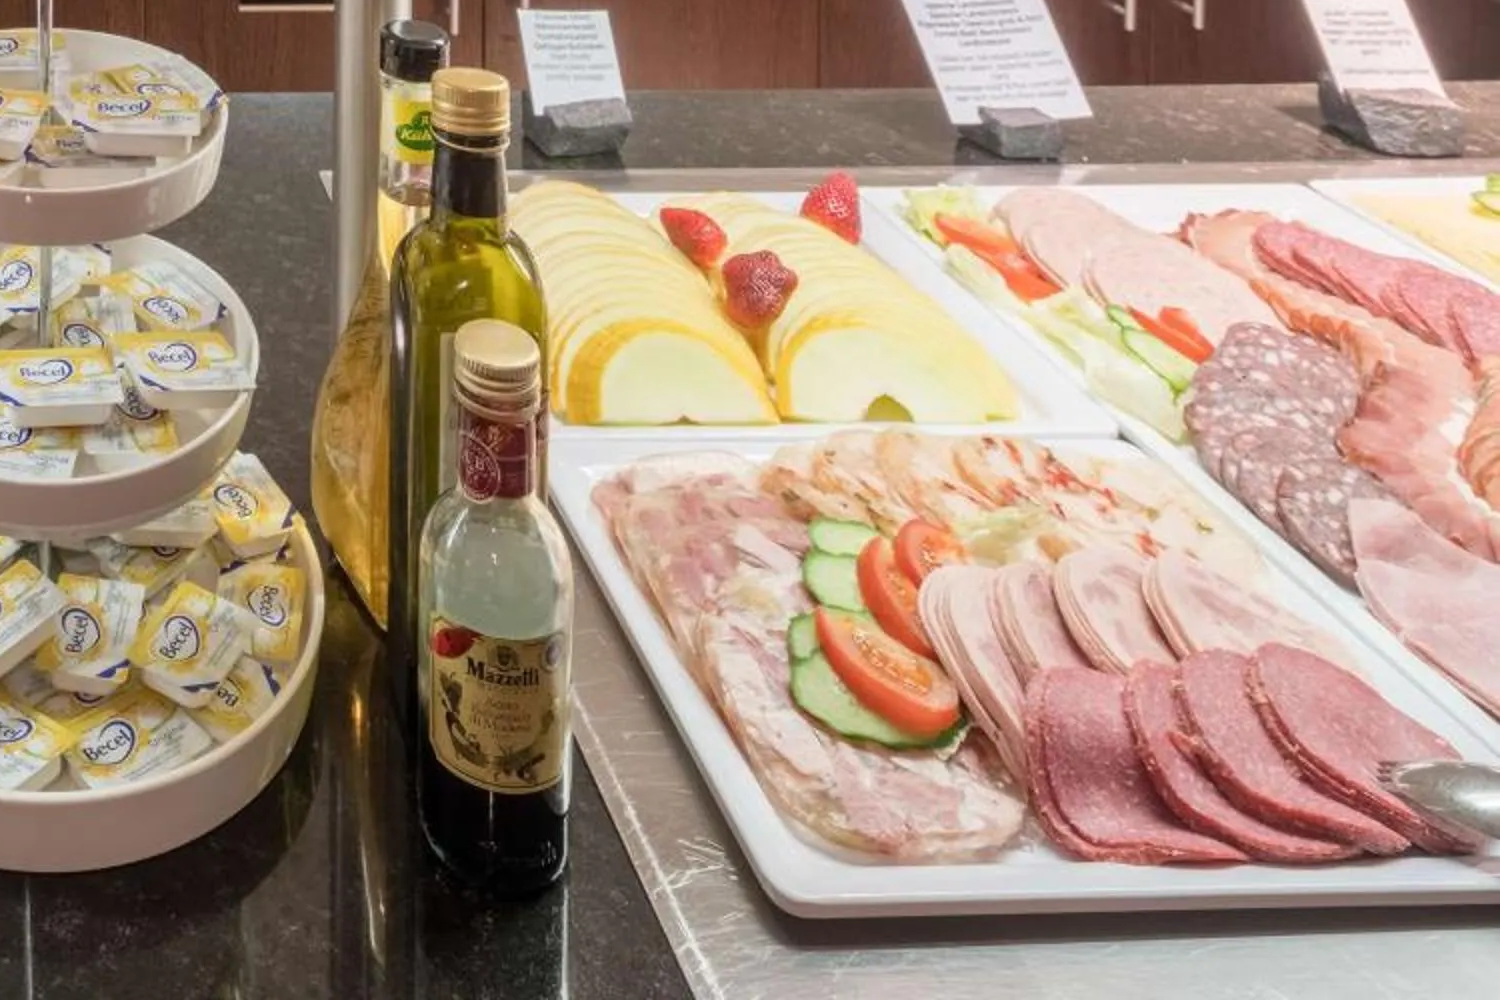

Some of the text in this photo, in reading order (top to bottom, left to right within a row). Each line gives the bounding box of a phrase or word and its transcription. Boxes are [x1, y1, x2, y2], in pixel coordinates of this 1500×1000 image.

[97, 100, 151, 115] Becel
[19, 359, 69, 378] Becel
[262, 584, 281, 620] Becel
[64, 614, 90, 653] Becel
[158, 620, 195, 659] Becel
[83, 727, 133, 762] Becel
